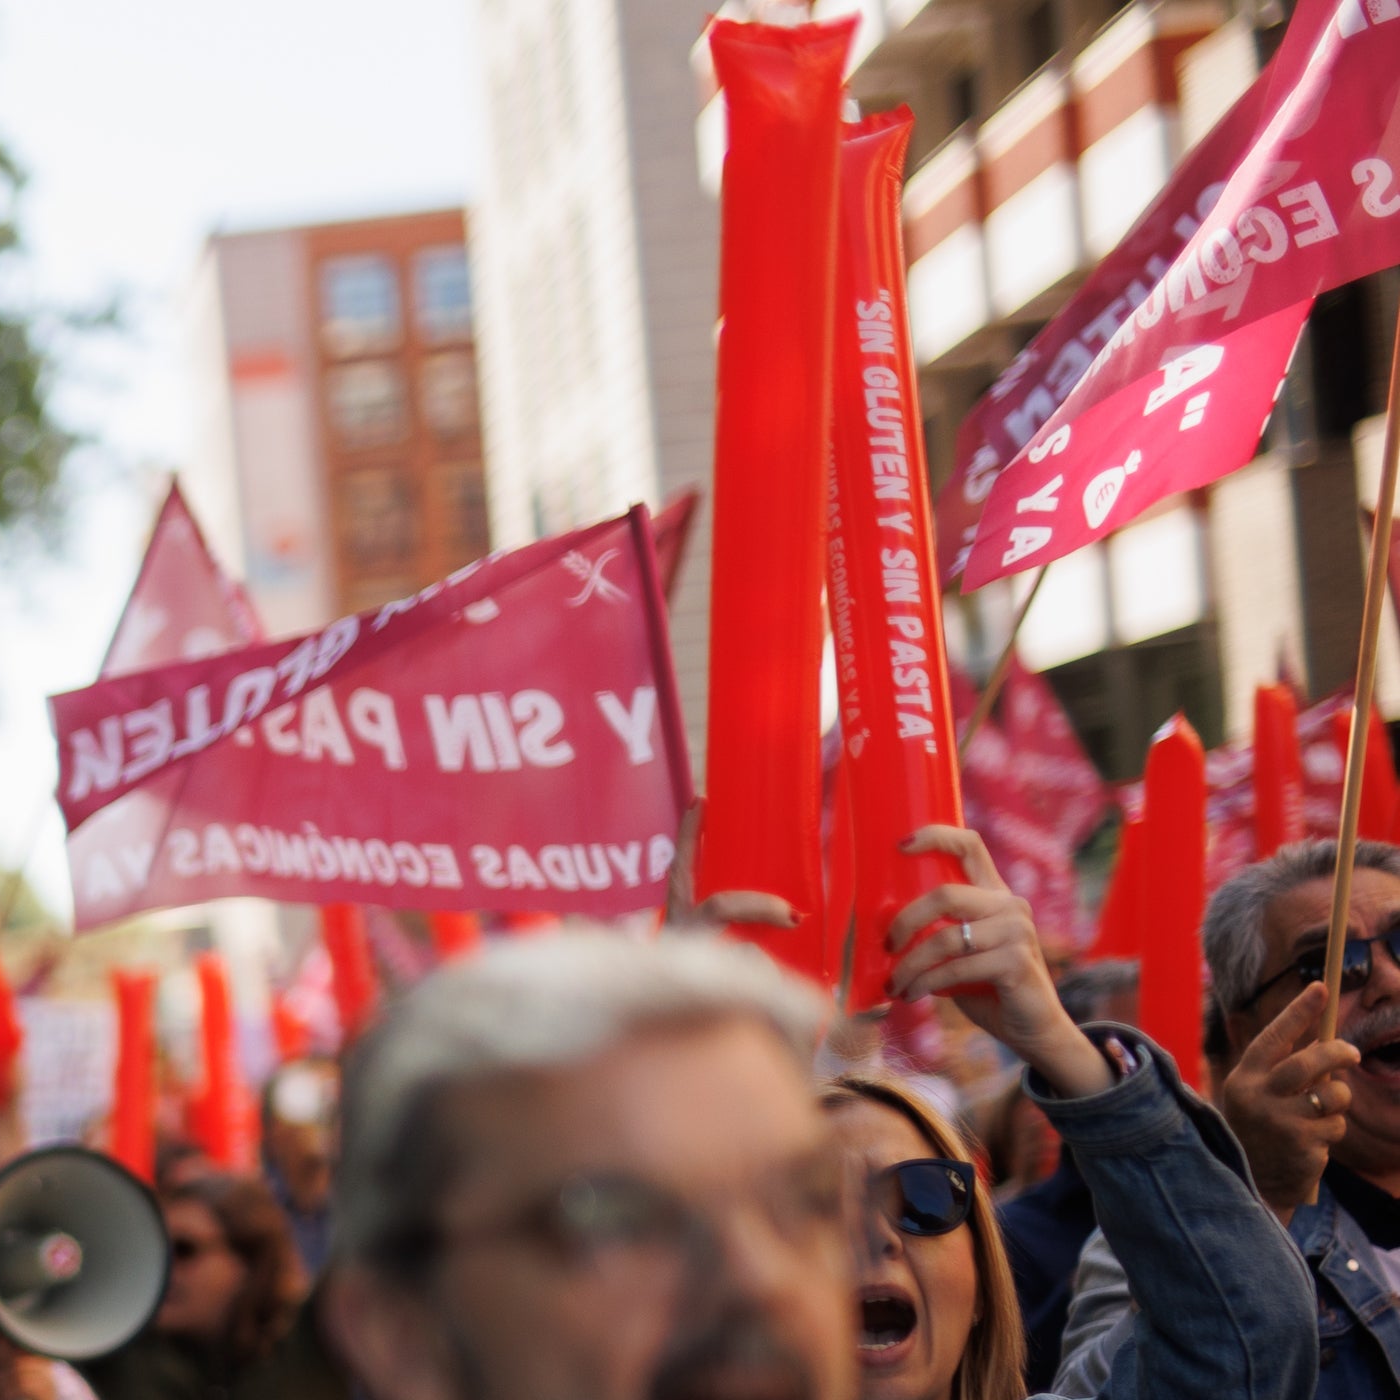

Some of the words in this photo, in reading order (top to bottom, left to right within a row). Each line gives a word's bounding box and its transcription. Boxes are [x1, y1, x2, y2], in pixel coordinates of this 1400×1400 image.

[862, 366, 912, 501] GLUTEN
[877, 511, 914, 536] Y
[880, 547, 921, 604] SIN
[887, 616, 938, 756] PASTA"
